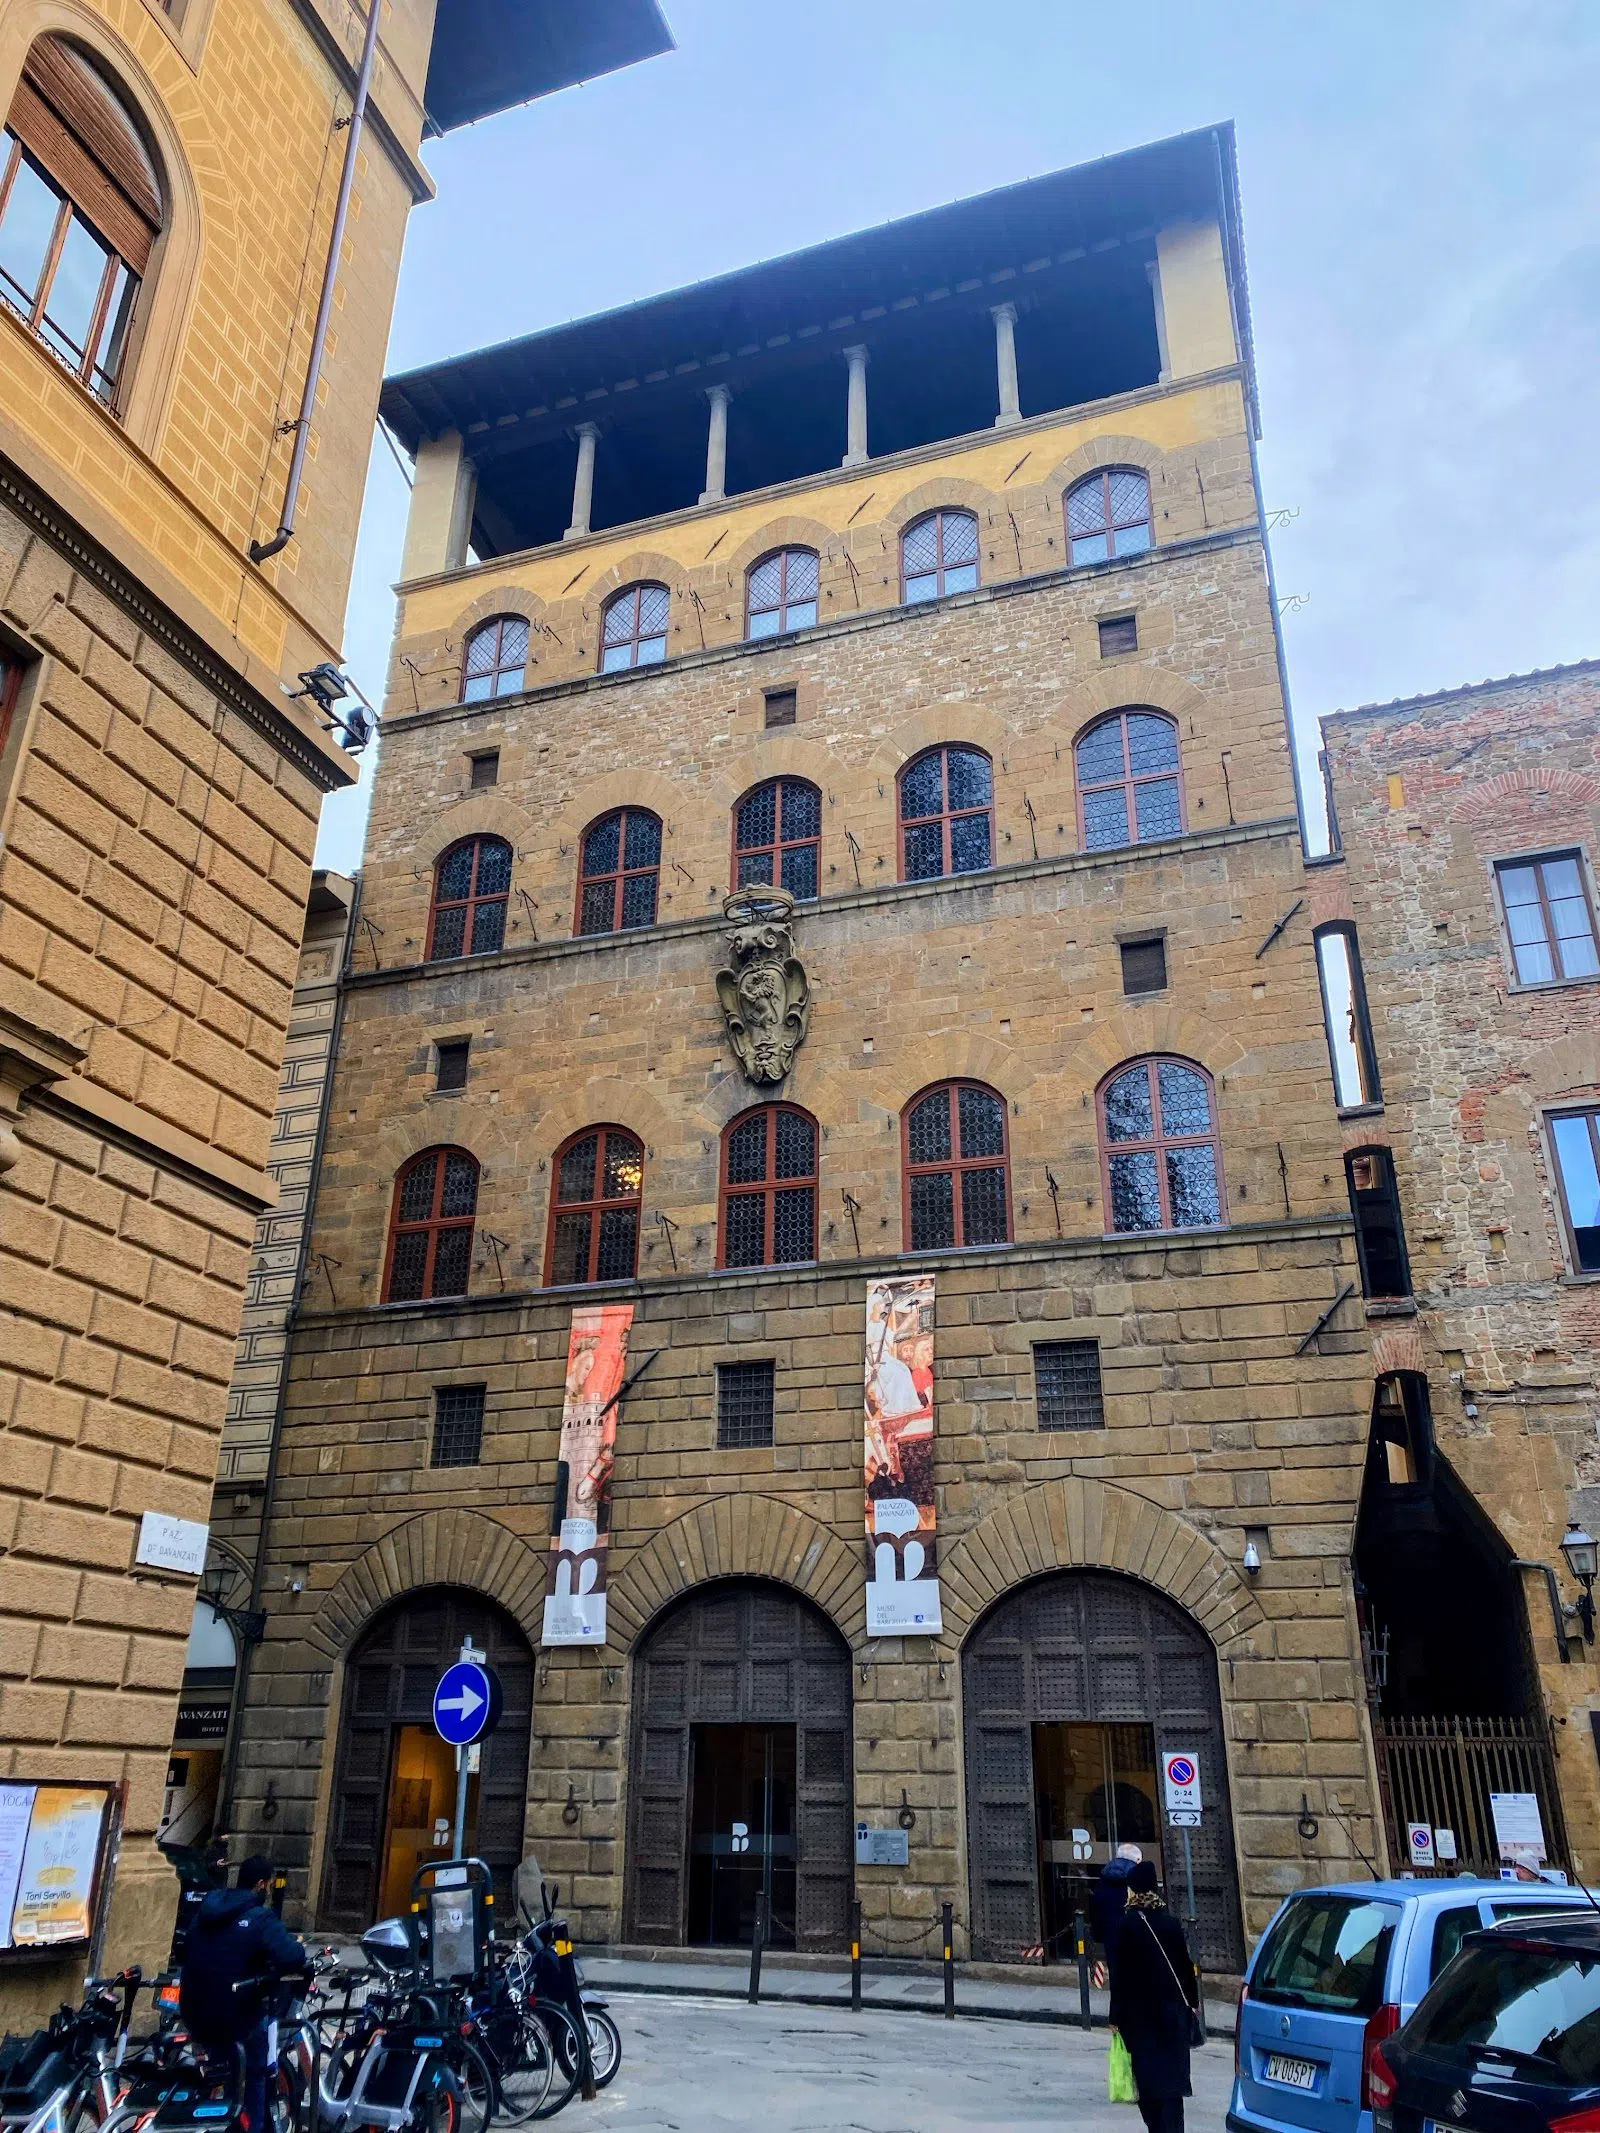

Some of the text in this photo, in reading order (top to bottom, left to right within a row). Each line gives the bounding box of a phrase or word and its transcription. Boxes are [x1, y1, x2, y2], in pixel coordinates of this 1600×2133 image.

[159, 1546, 199, 1562] DAVANZATI
[178, 1710, 228, 1720] AVANZATI
[2, 1793, 30, 1807] YOGA
